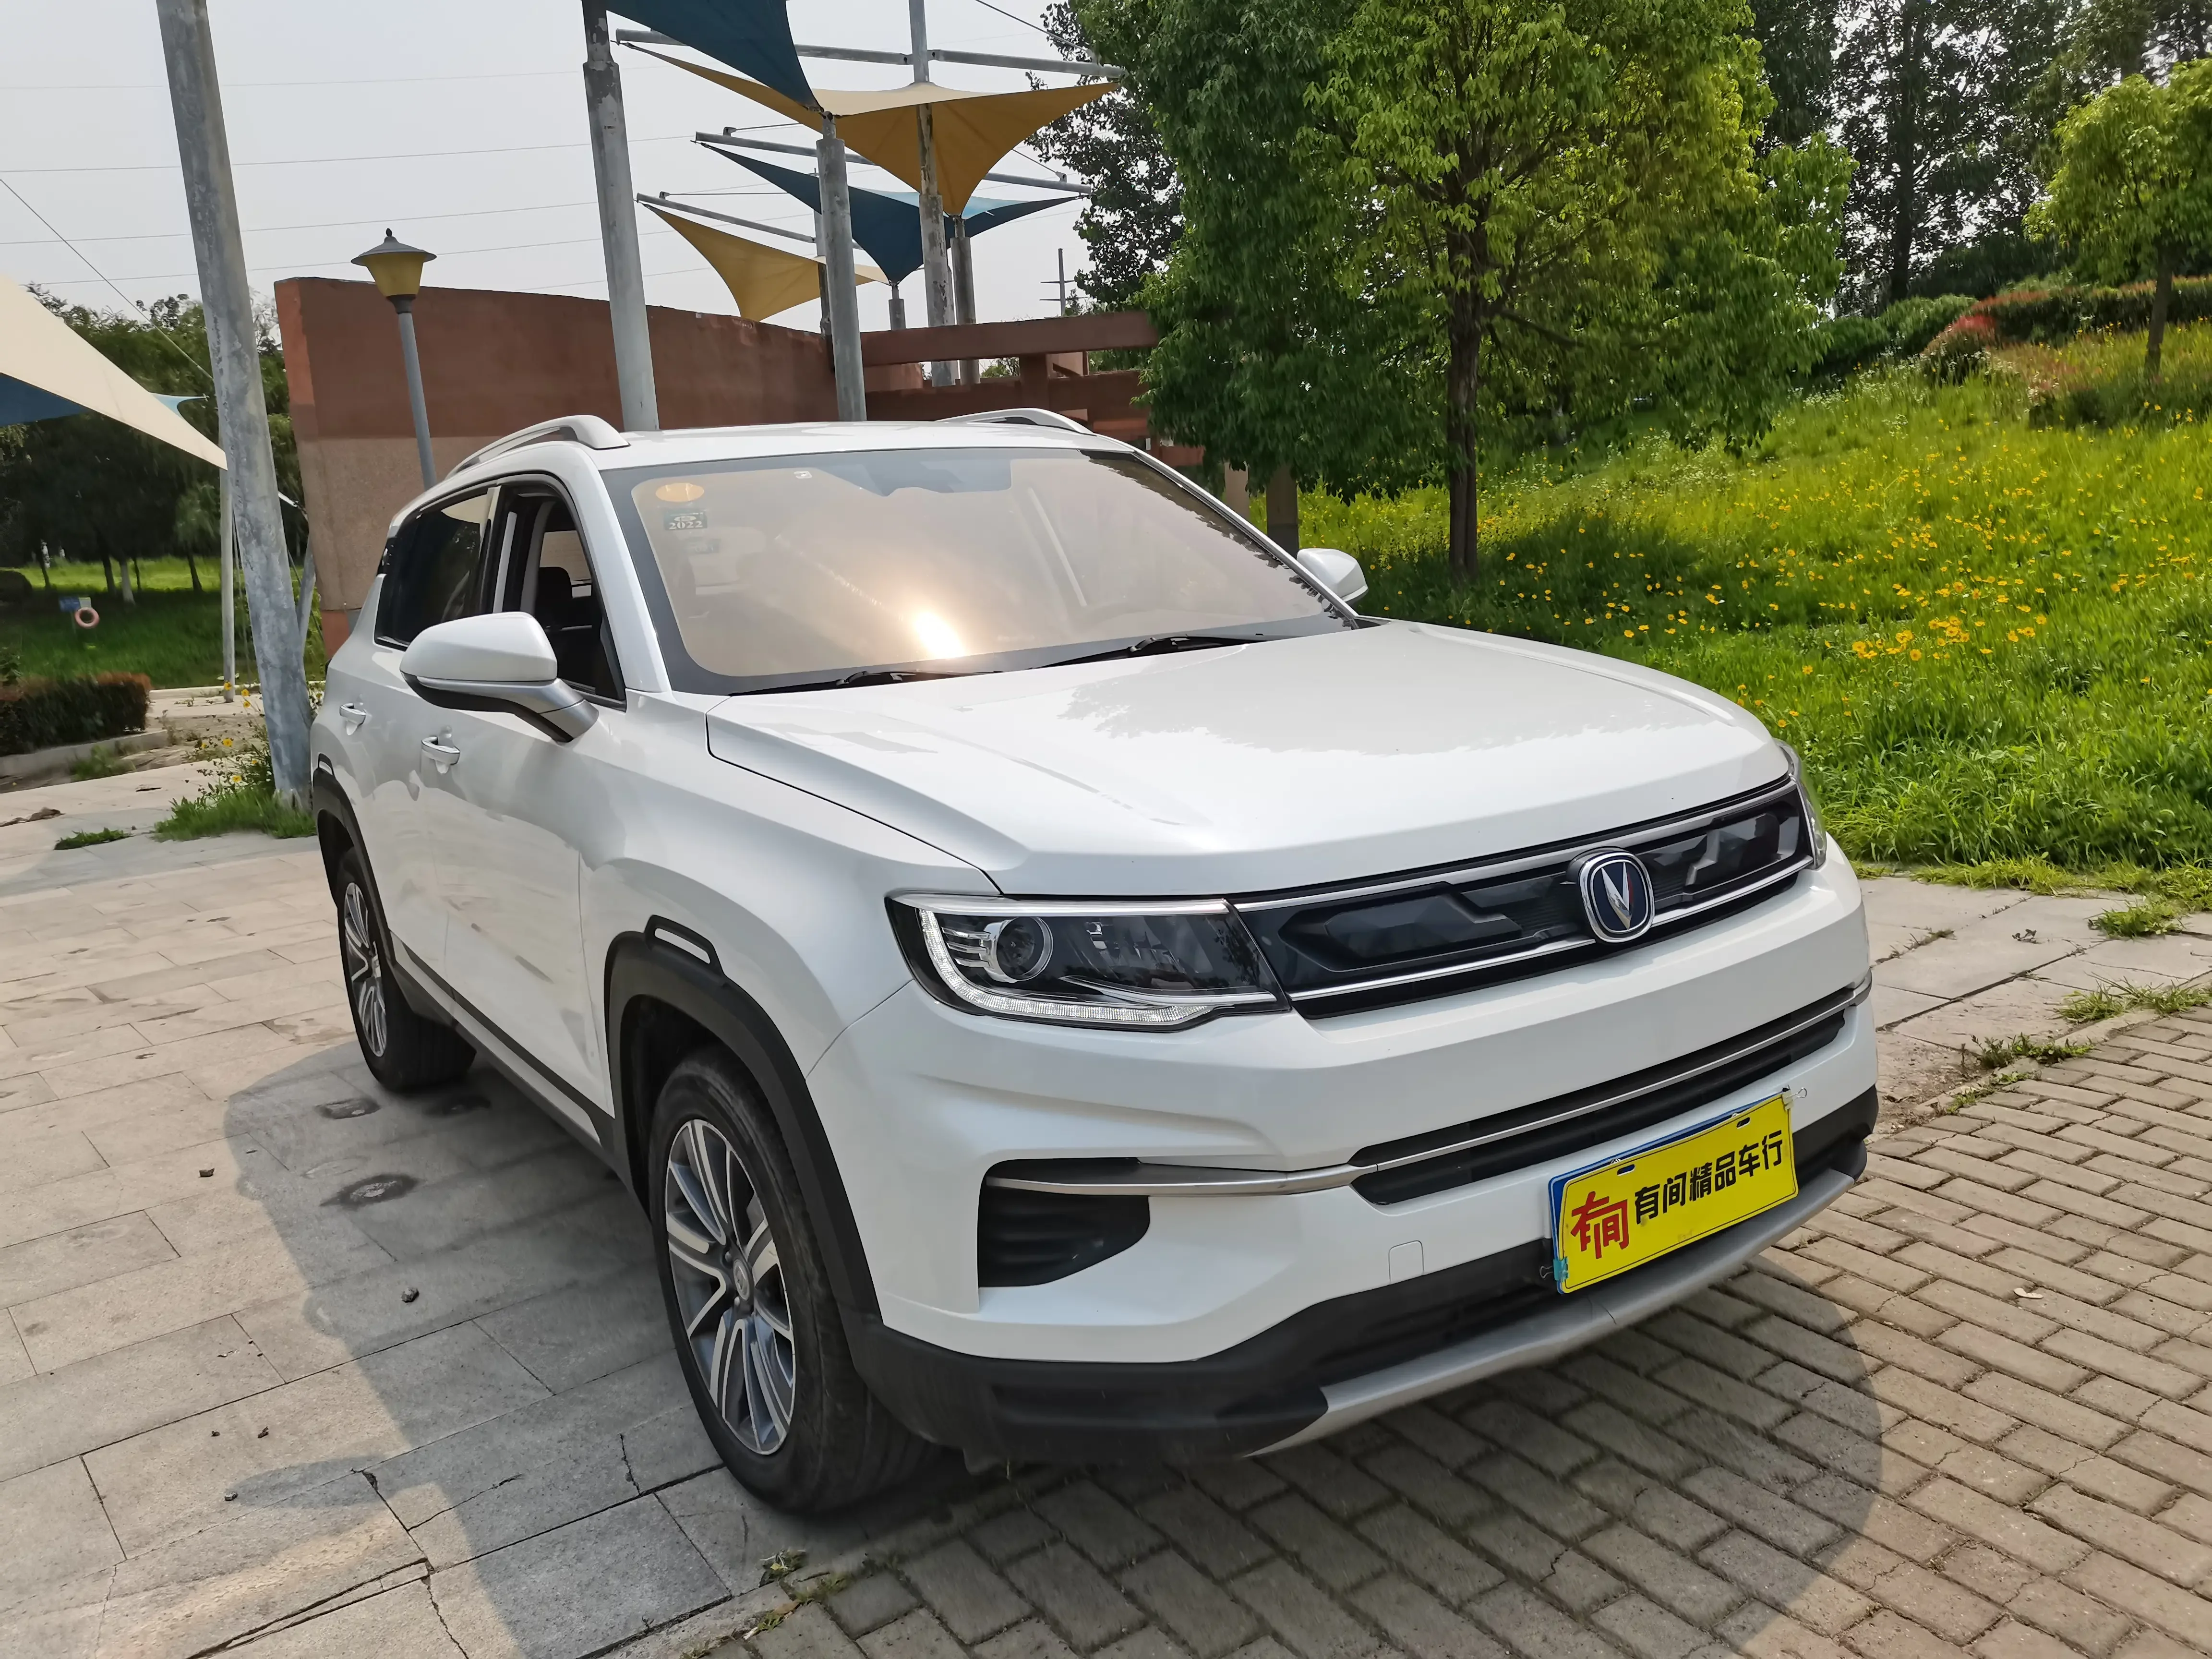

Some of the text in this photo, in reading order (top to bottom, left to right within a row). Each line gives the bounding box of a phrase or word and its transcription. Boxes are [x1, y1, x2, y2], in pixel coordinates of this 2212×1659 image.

[669, 520, 703, 530] 2022
[1634, 1130, 1783, 1225] 有间精品车行
